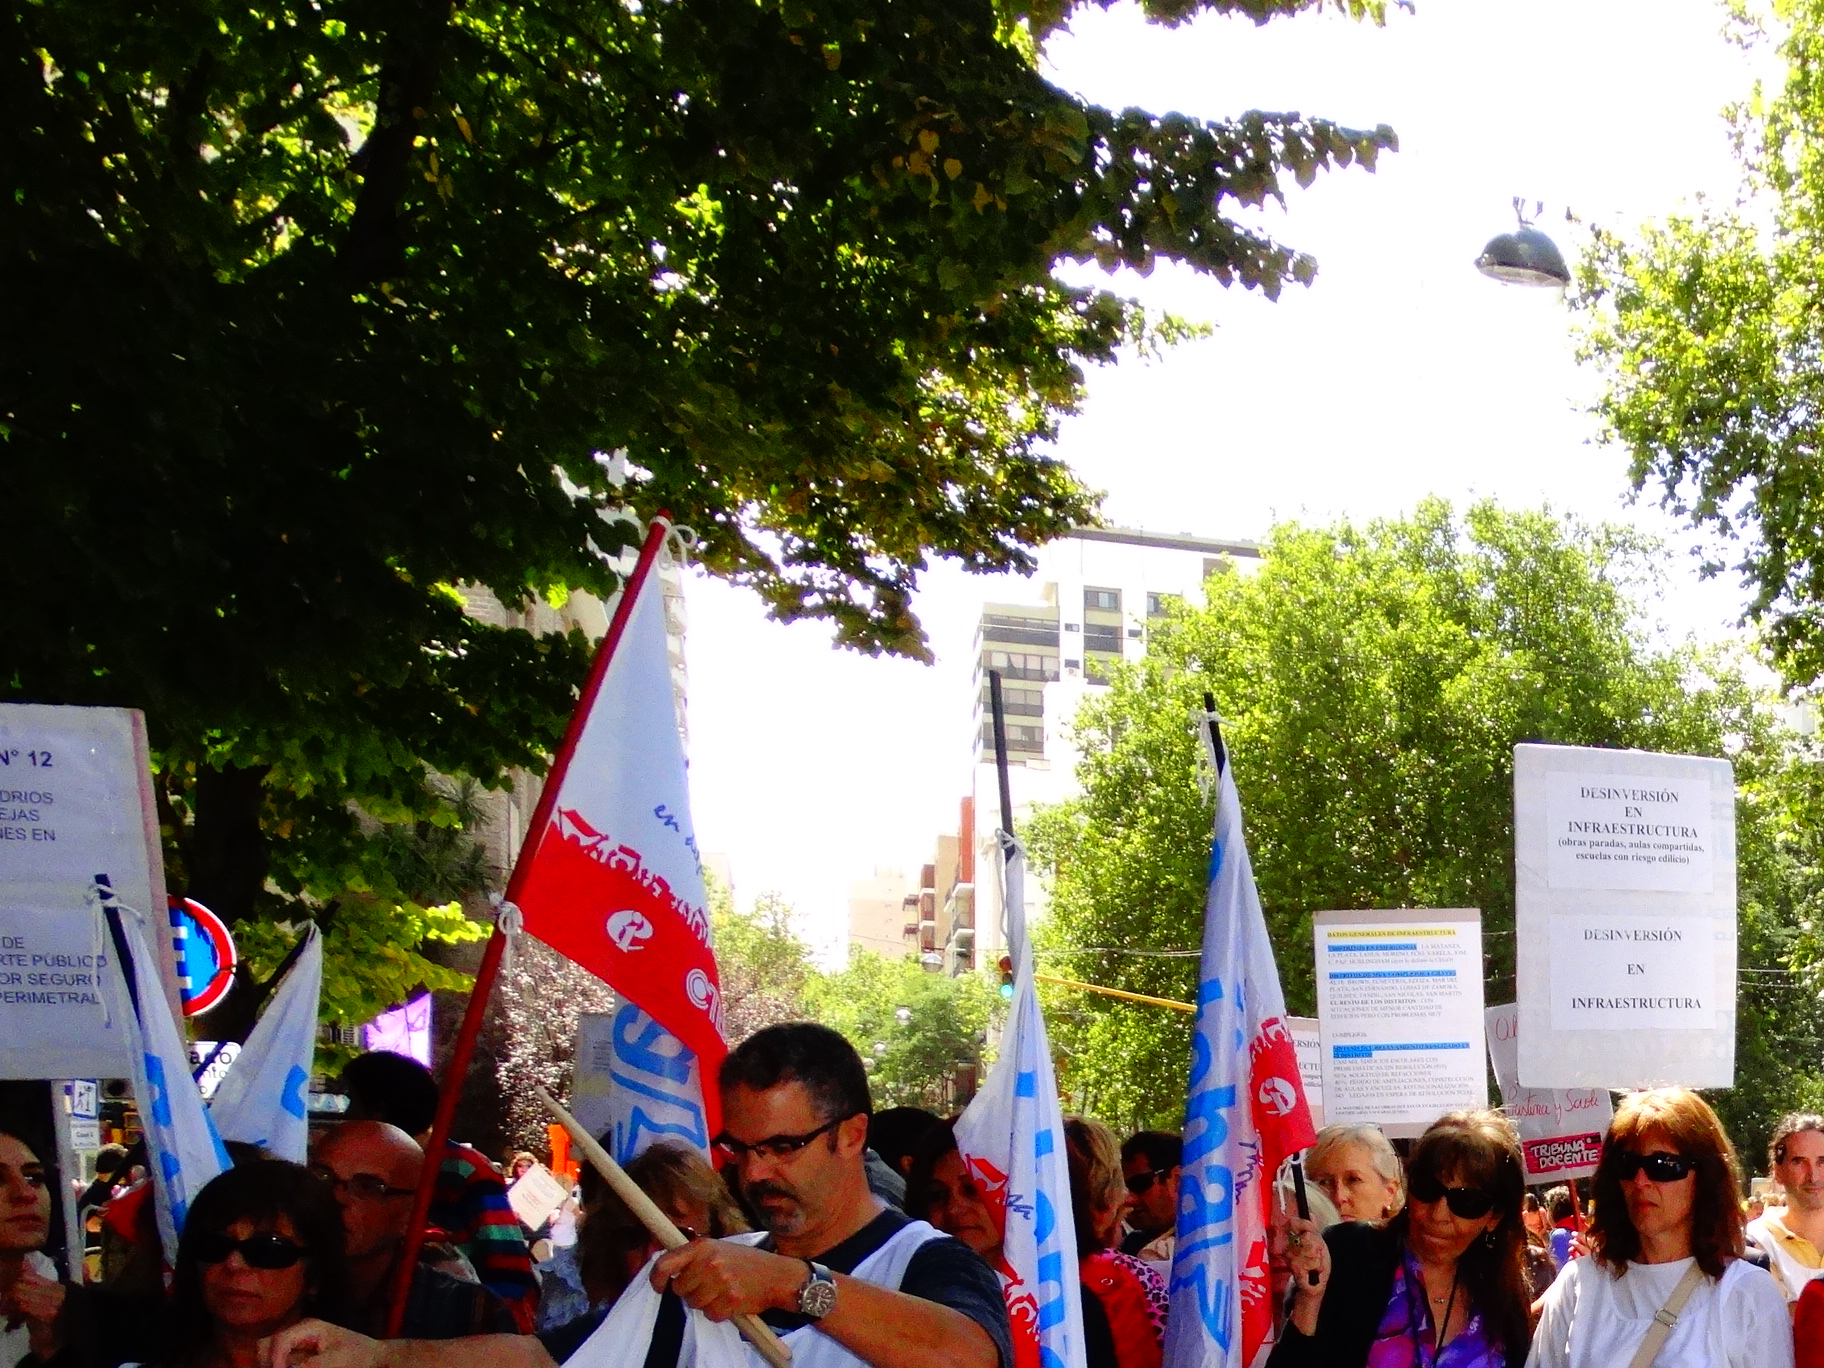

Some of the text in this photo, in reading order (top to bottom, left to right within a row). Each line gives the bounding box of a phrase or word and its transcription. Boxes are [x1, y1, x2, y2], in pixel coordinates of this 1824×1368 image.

[28, 750, 53, 767] 12
[1580, 786, 1679, 803] DESINVERSIÓN
[1625, 806, 1642, 818] EN
[32, 828, 56, 841] EN
[1568, 821, 1698, 838] INFRAESTRUCTURA
[1558, 837, 1705, 853] (obras paradas, aulas compartidas,
[1575, 852, 1611, 861] escuelas
[1631, 853, 1657, 864] riesgo
[1584, 926, 1682, 941] DESINVERSIÓN
[2, 936, 25, 949] DE
[32, 952, 107, 968] PÚBLICO
[1627, 963, 1645, 975] EN
[0, 990, 101, 1005] ERIMETRAL
[1572, 997, 1701, 1009] INFRAESTRUCTURA
[1531, 1139, 1586, 1158] TRIBUNA
[1538, 1150, 1599, 1170] DOCENTE
